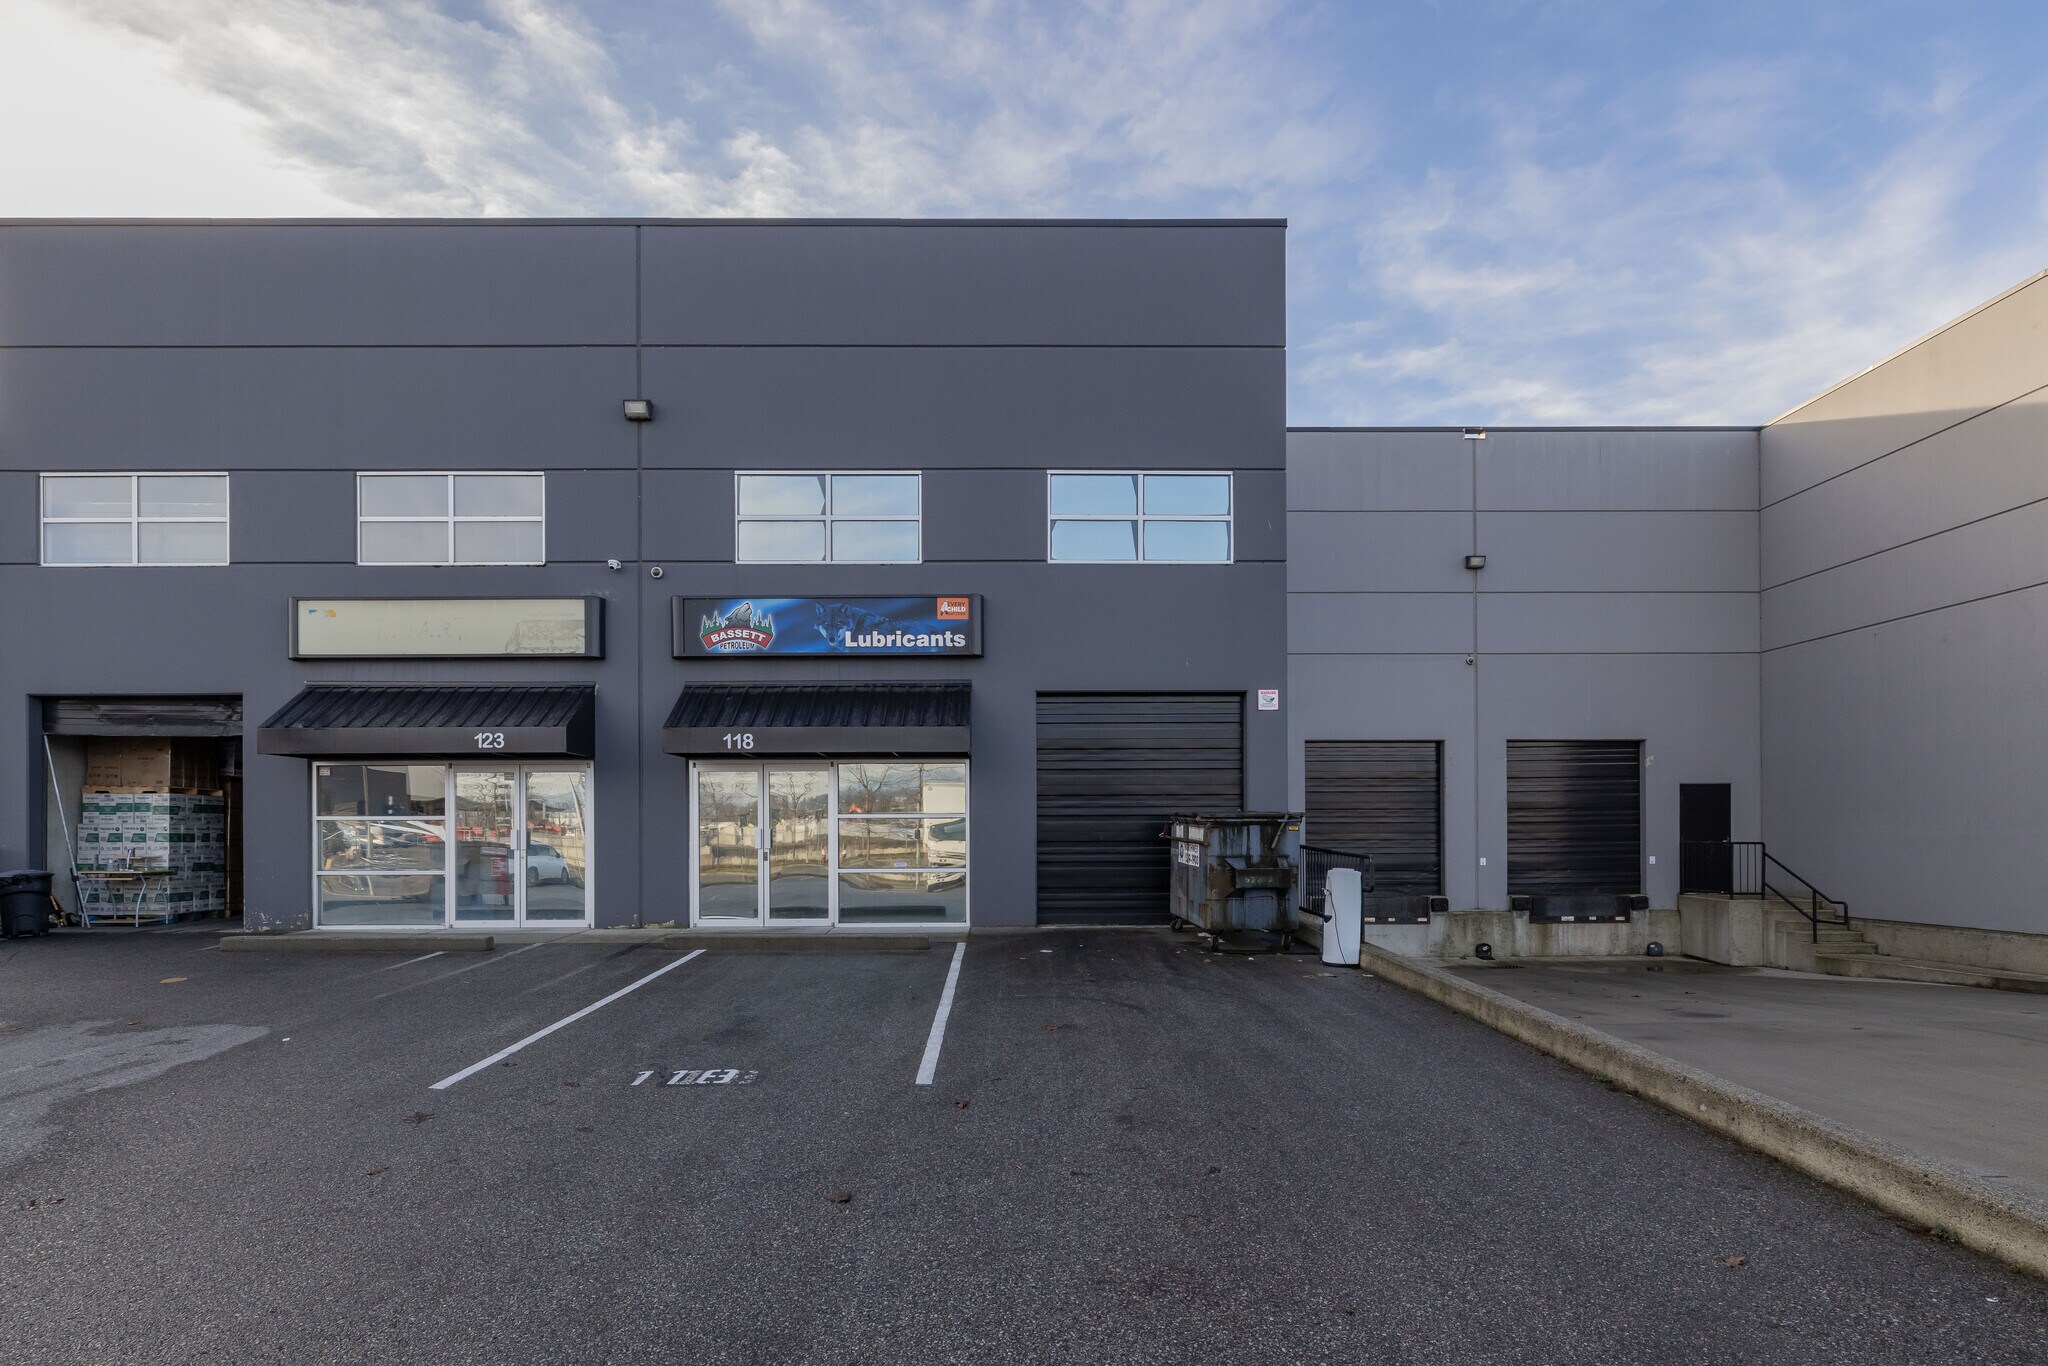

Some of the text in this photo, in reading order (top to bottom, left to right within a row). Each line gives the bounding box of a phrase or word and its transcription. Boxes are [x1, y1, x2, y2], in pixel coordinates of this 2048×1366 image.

[710, 629, 766, 643] BASSETT
[845, 630, 966, 647] Lubricants
[719, 641, 755, 650] PETROLEUM
[474, 732, 505, 749] 123
[722, 733, 754, 750] 118
